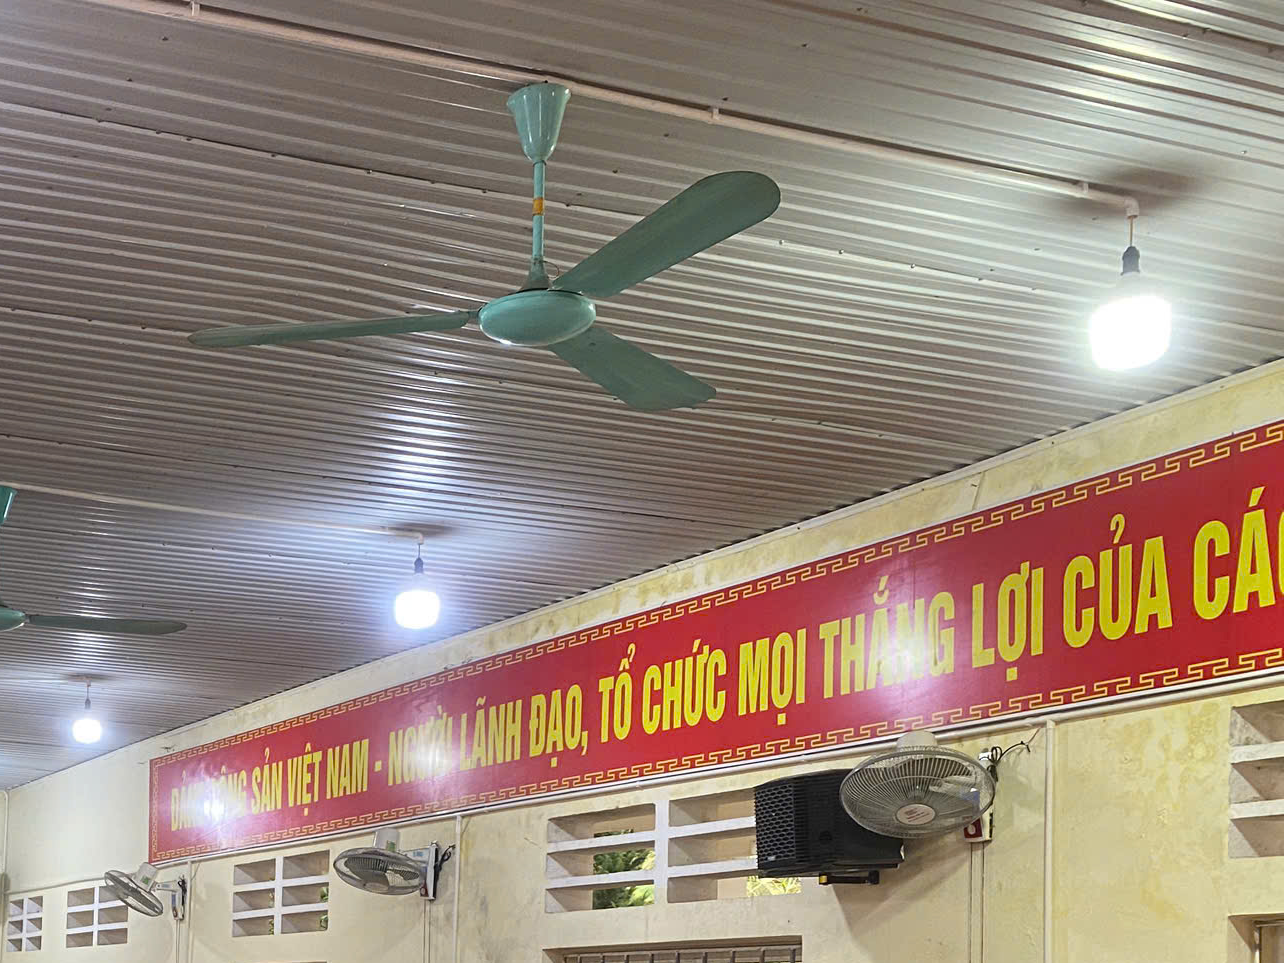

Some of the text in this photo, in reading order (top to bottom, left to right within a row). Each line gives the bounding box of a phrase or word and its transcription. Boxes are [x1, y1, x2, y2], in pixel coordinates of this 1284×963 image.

[171, 770, 206, 832] ĐẢN
[207, 766, 247, 825] NG
[251, 747, 282, 815] SẢN
[287, 743, 322, 816] VIỆT
[326, 739, 369, 799] NAM
[388, 704, 453, 786] NGƯỜI
[460, 695, 523, 771] LÃNH
[529, 684, 589, 768] ĐẠO,
[598, 643, 636, 743] TỔ
[642, 638, 727, 735] CHỨC
[738, 627, 807, 725] MỌI
[819, 576, 956, 699] THẮNG
[971, 561, 1045, 681] LỢI
[1062, 513, 1173, 648] CỦA
[1193, 486, 1284, 620] CÁ
